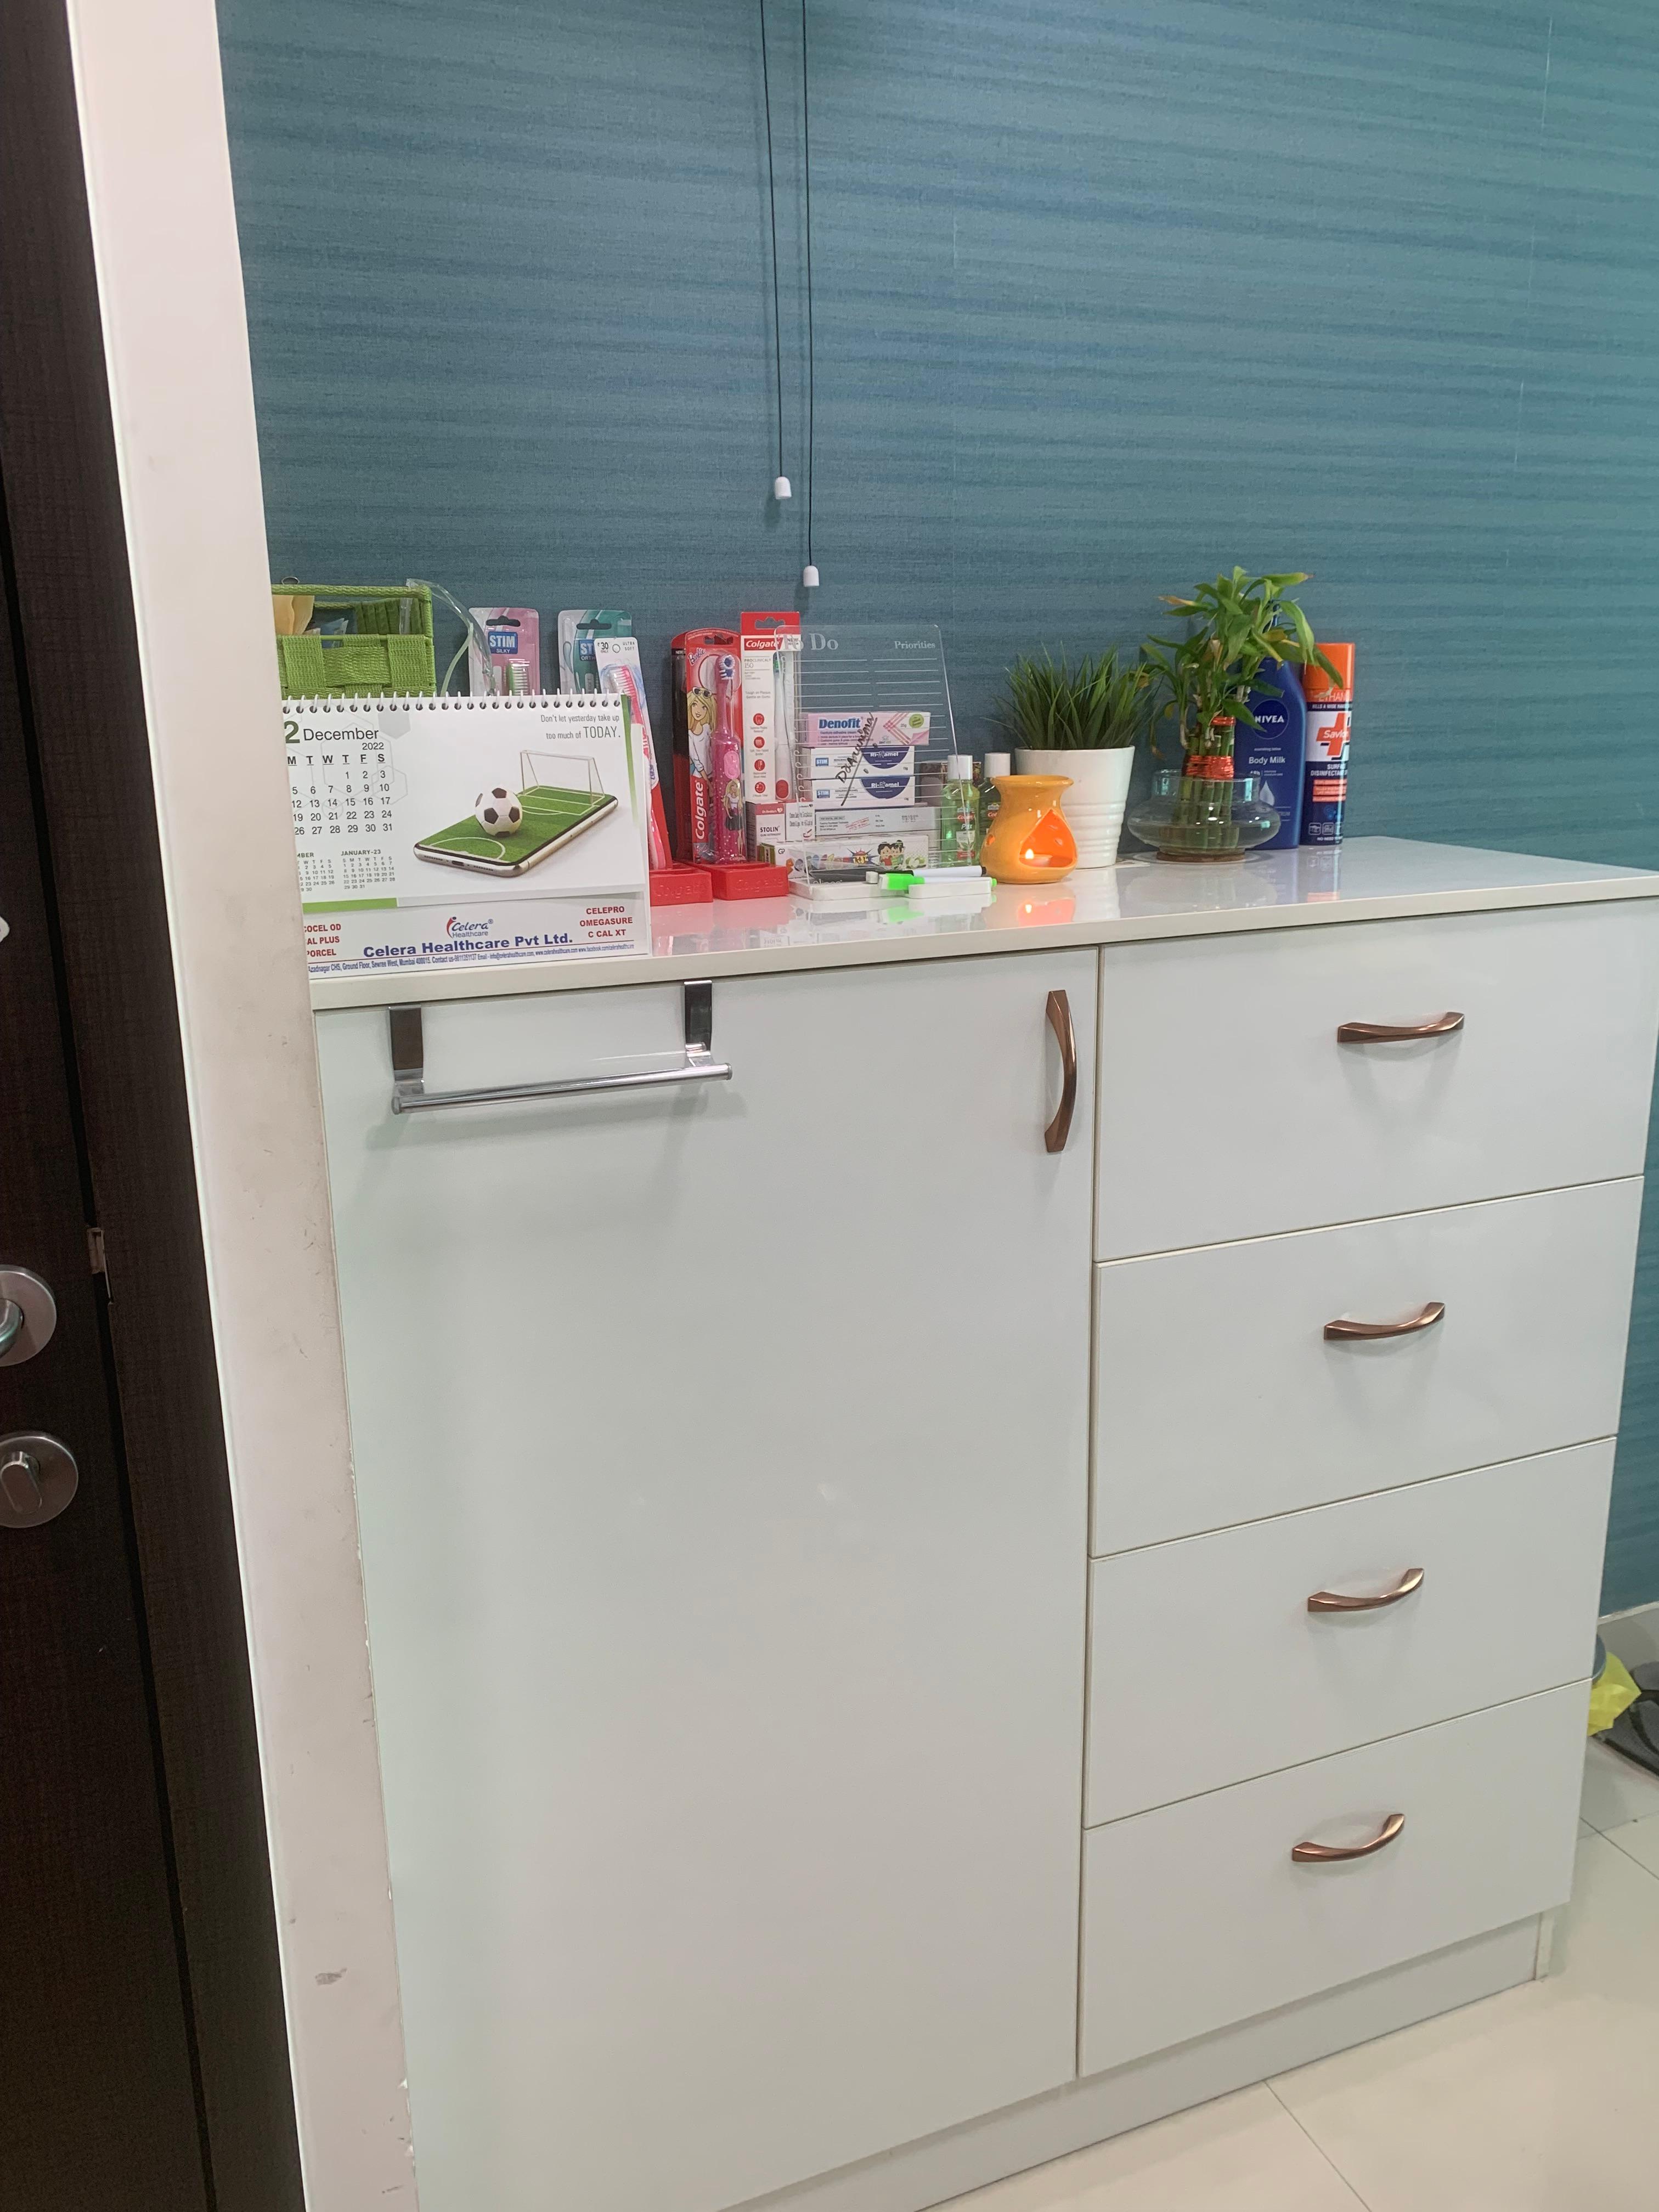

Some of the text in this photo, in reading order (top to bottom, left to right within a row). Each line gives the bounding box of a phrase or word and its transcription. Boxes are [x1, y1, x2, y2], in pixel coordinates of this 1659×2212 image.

[489, 635, 515, 648] STIM
[746, 640, 780, 649] Colgate
[809, 633, 839, 650] Do
[894, 641, 936, 650] Priorities
[568, 715, 596, 723] yesterday
[819, 718, 860, 729] Denofit
[1255, 715, 1284, 724] NIVEA
[303, 728, 379, 741] December
[583, 726, 620, 738] TODAY.
[307, 756, 313, 764] T
[342, 755, 349, 763] T
[360, 754, 366, 763] F
[1249, 757, 1268, 765] Body
[695, 782, 707, 839] Colgate
[586, 906, 625, 915] CELEPRO
[452, 922, 489, 931] Celera
[579, 917, 633, 927] OMEGASURE
[319, 936, 340, 944] PLUS
[363, 933, 573, 958] Celera Healthcare Pvt Ltd.
